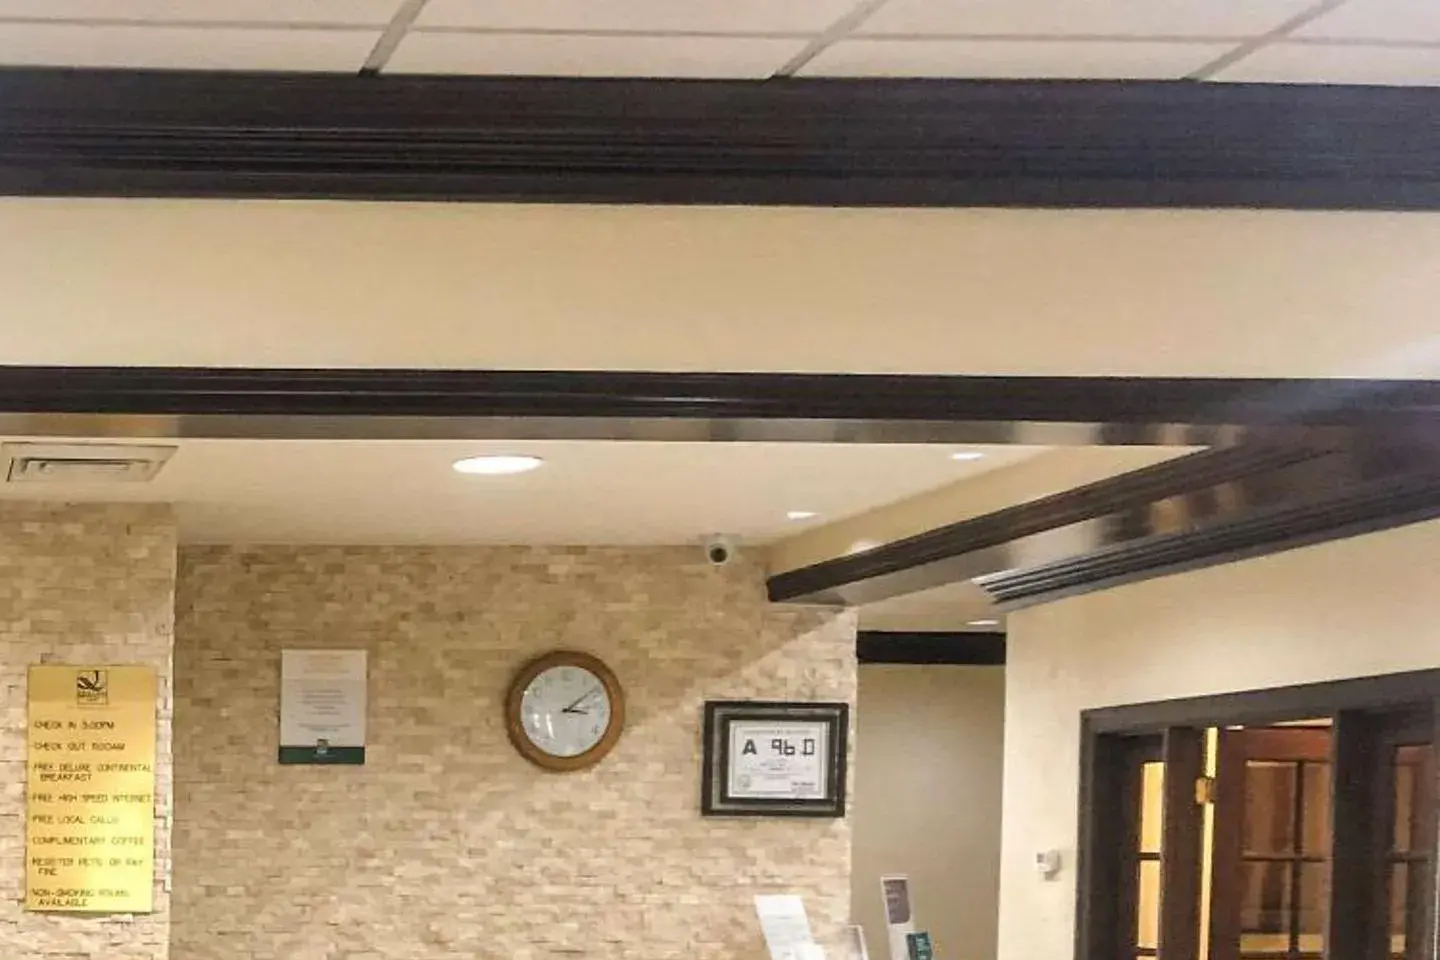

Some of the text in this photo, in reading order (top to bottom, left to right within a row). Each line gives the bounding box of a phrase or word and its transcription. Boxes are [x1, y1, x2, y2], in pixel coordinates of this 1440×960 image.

[33, 721, 62, 730] CHECK
[68, 721, 77, 730] IN
[33, 742, 62, 751] CHECK
[67, 742, 86, 751] OUT
[742, 739, 758, 755] A
[33, 763, 54, 772] FREE
[39, 773, 92, 782] BREAKFAST
[32, 793, 54, 802] FREE
[32, 815, 55, 825] FREE
[57, 815, 86, 825] LOCAL
[39, 898, 89, 907] AVAILABLE
